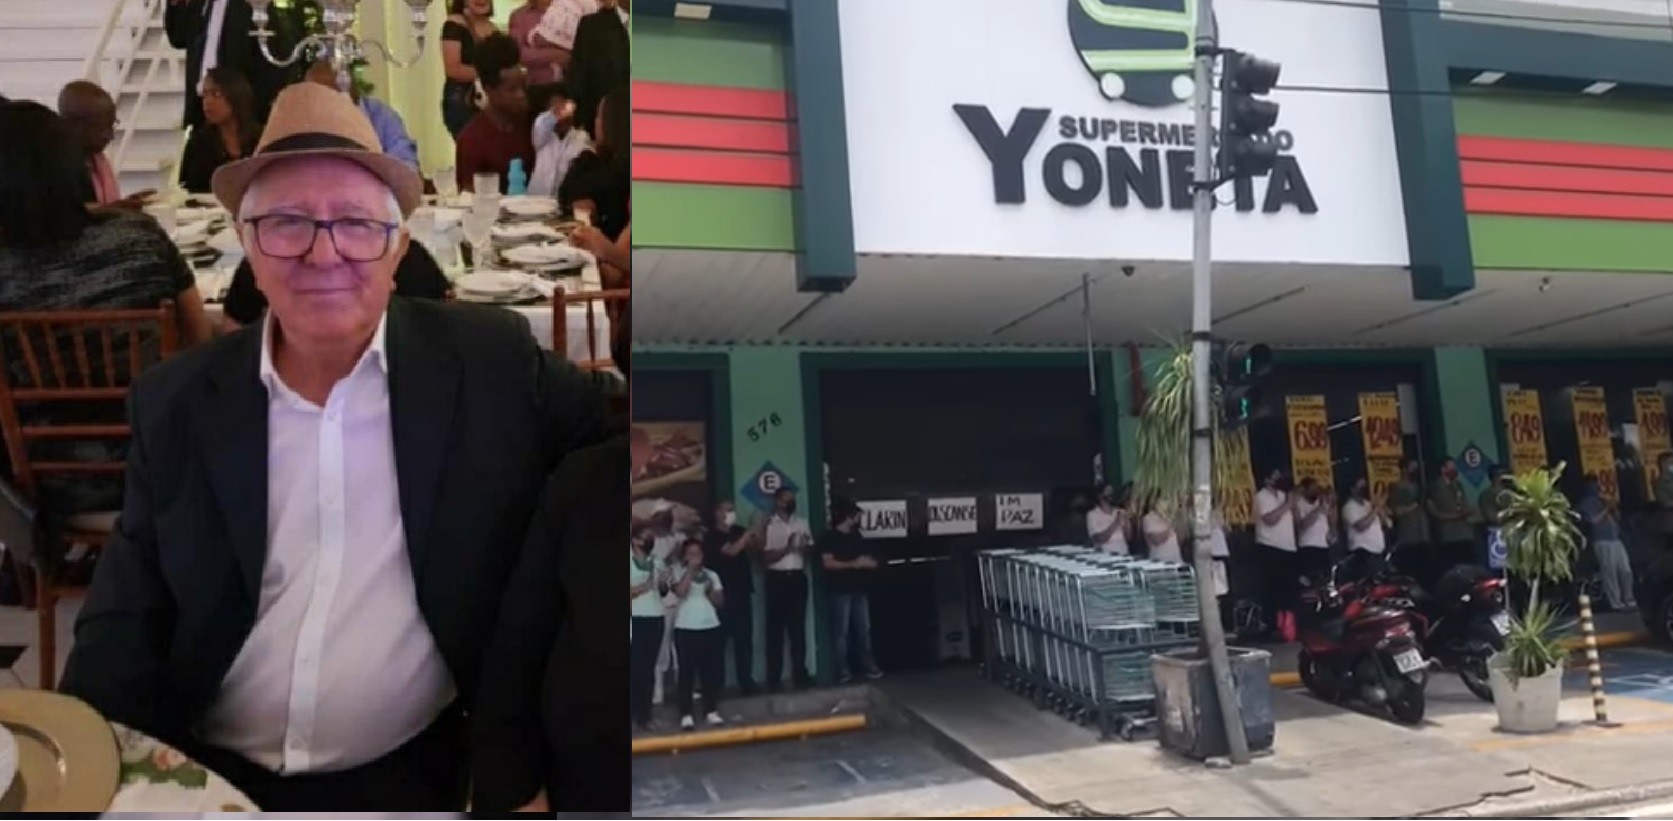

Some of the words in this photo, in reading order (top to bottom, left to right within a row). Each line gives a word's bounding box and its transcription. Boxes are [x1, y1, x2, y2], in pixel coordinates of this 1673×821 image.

[1058, 115, 1294, 152] SUPERMEDO
[1468, 451, 1476, 464] E
[764, 474, 776, 490] E
